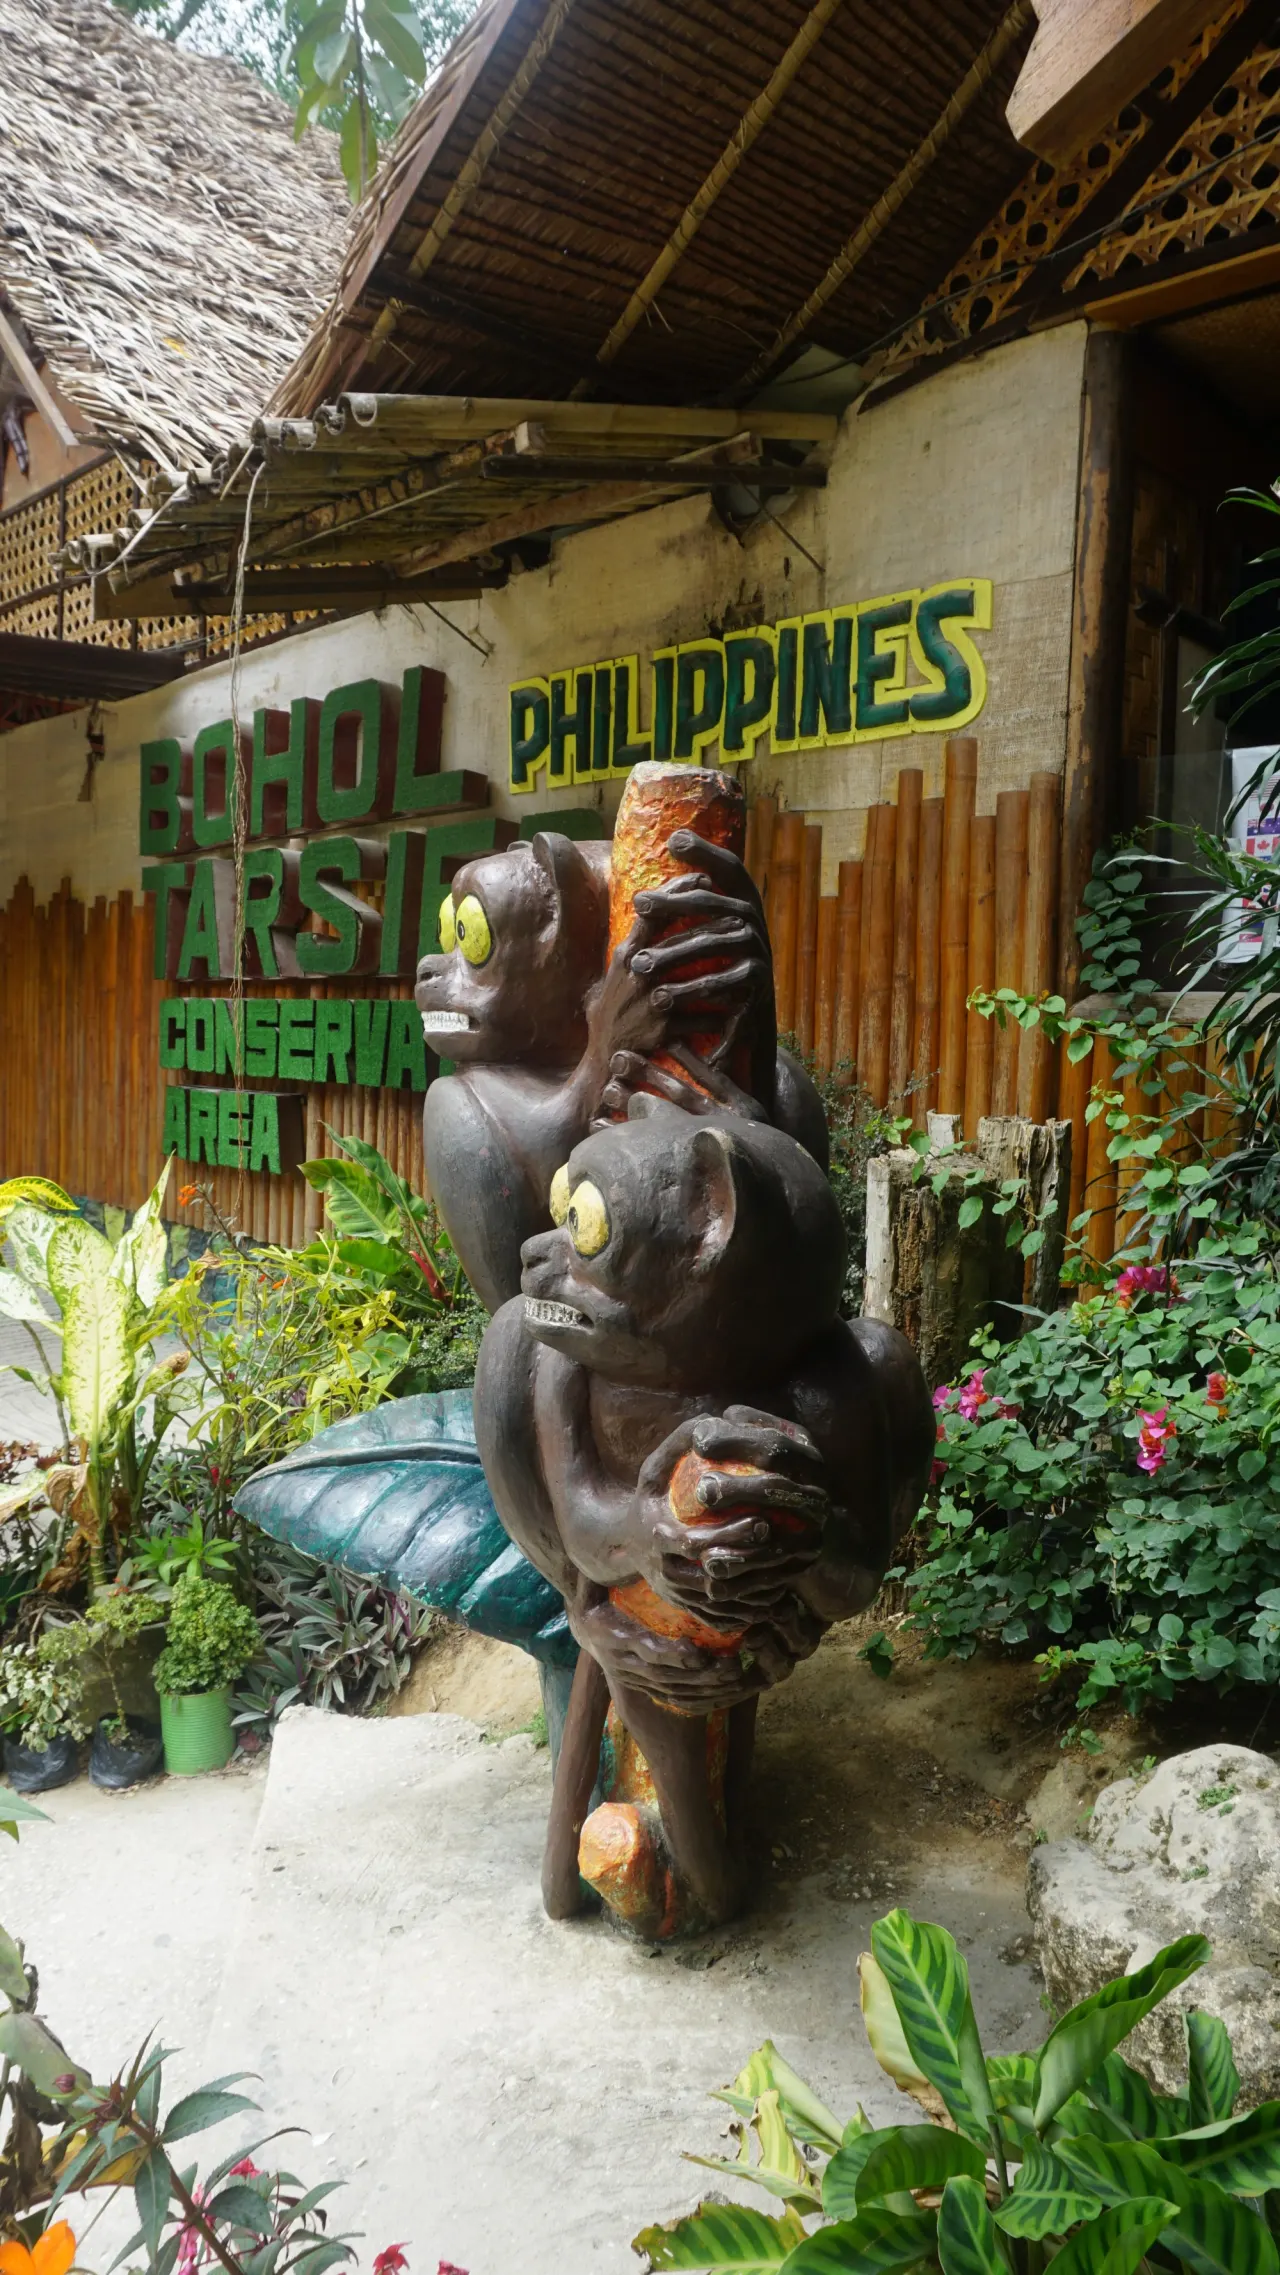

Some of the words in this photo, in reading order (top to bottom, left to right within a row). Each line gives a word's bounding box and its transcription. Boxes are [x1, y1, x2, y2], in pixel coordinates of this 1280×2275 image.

[140, 666, 482, 856] BOHOL
[509, 580, 987, 791] PHILIPPINES
[142, 809, 601, 980] TARSIE
[160, 998, 456, 1092] CONSERVA
[163, 1086, 283, 1175] AREA
